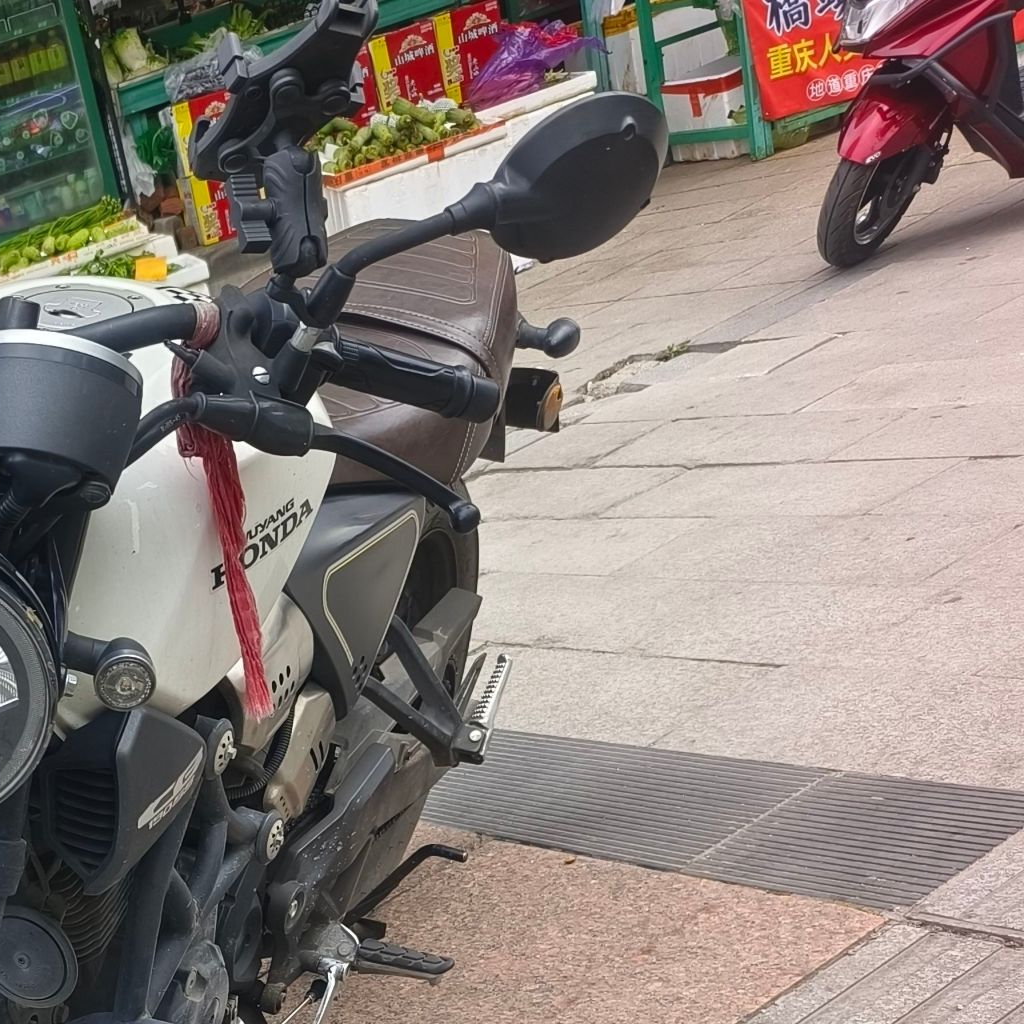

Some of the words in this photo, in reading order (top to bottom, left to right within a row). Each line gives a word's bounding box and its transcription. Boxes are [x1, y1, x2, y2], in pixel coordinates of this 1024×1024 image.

[457, 21, 499, 45] 山城啤酒
[394, 43, 436, 67] 山城啤酒
[767, 33, 863, 80] 重庆人
[807, 62, 882, 101] 地道重庆
[210, 498, 314, 591] HONDA
